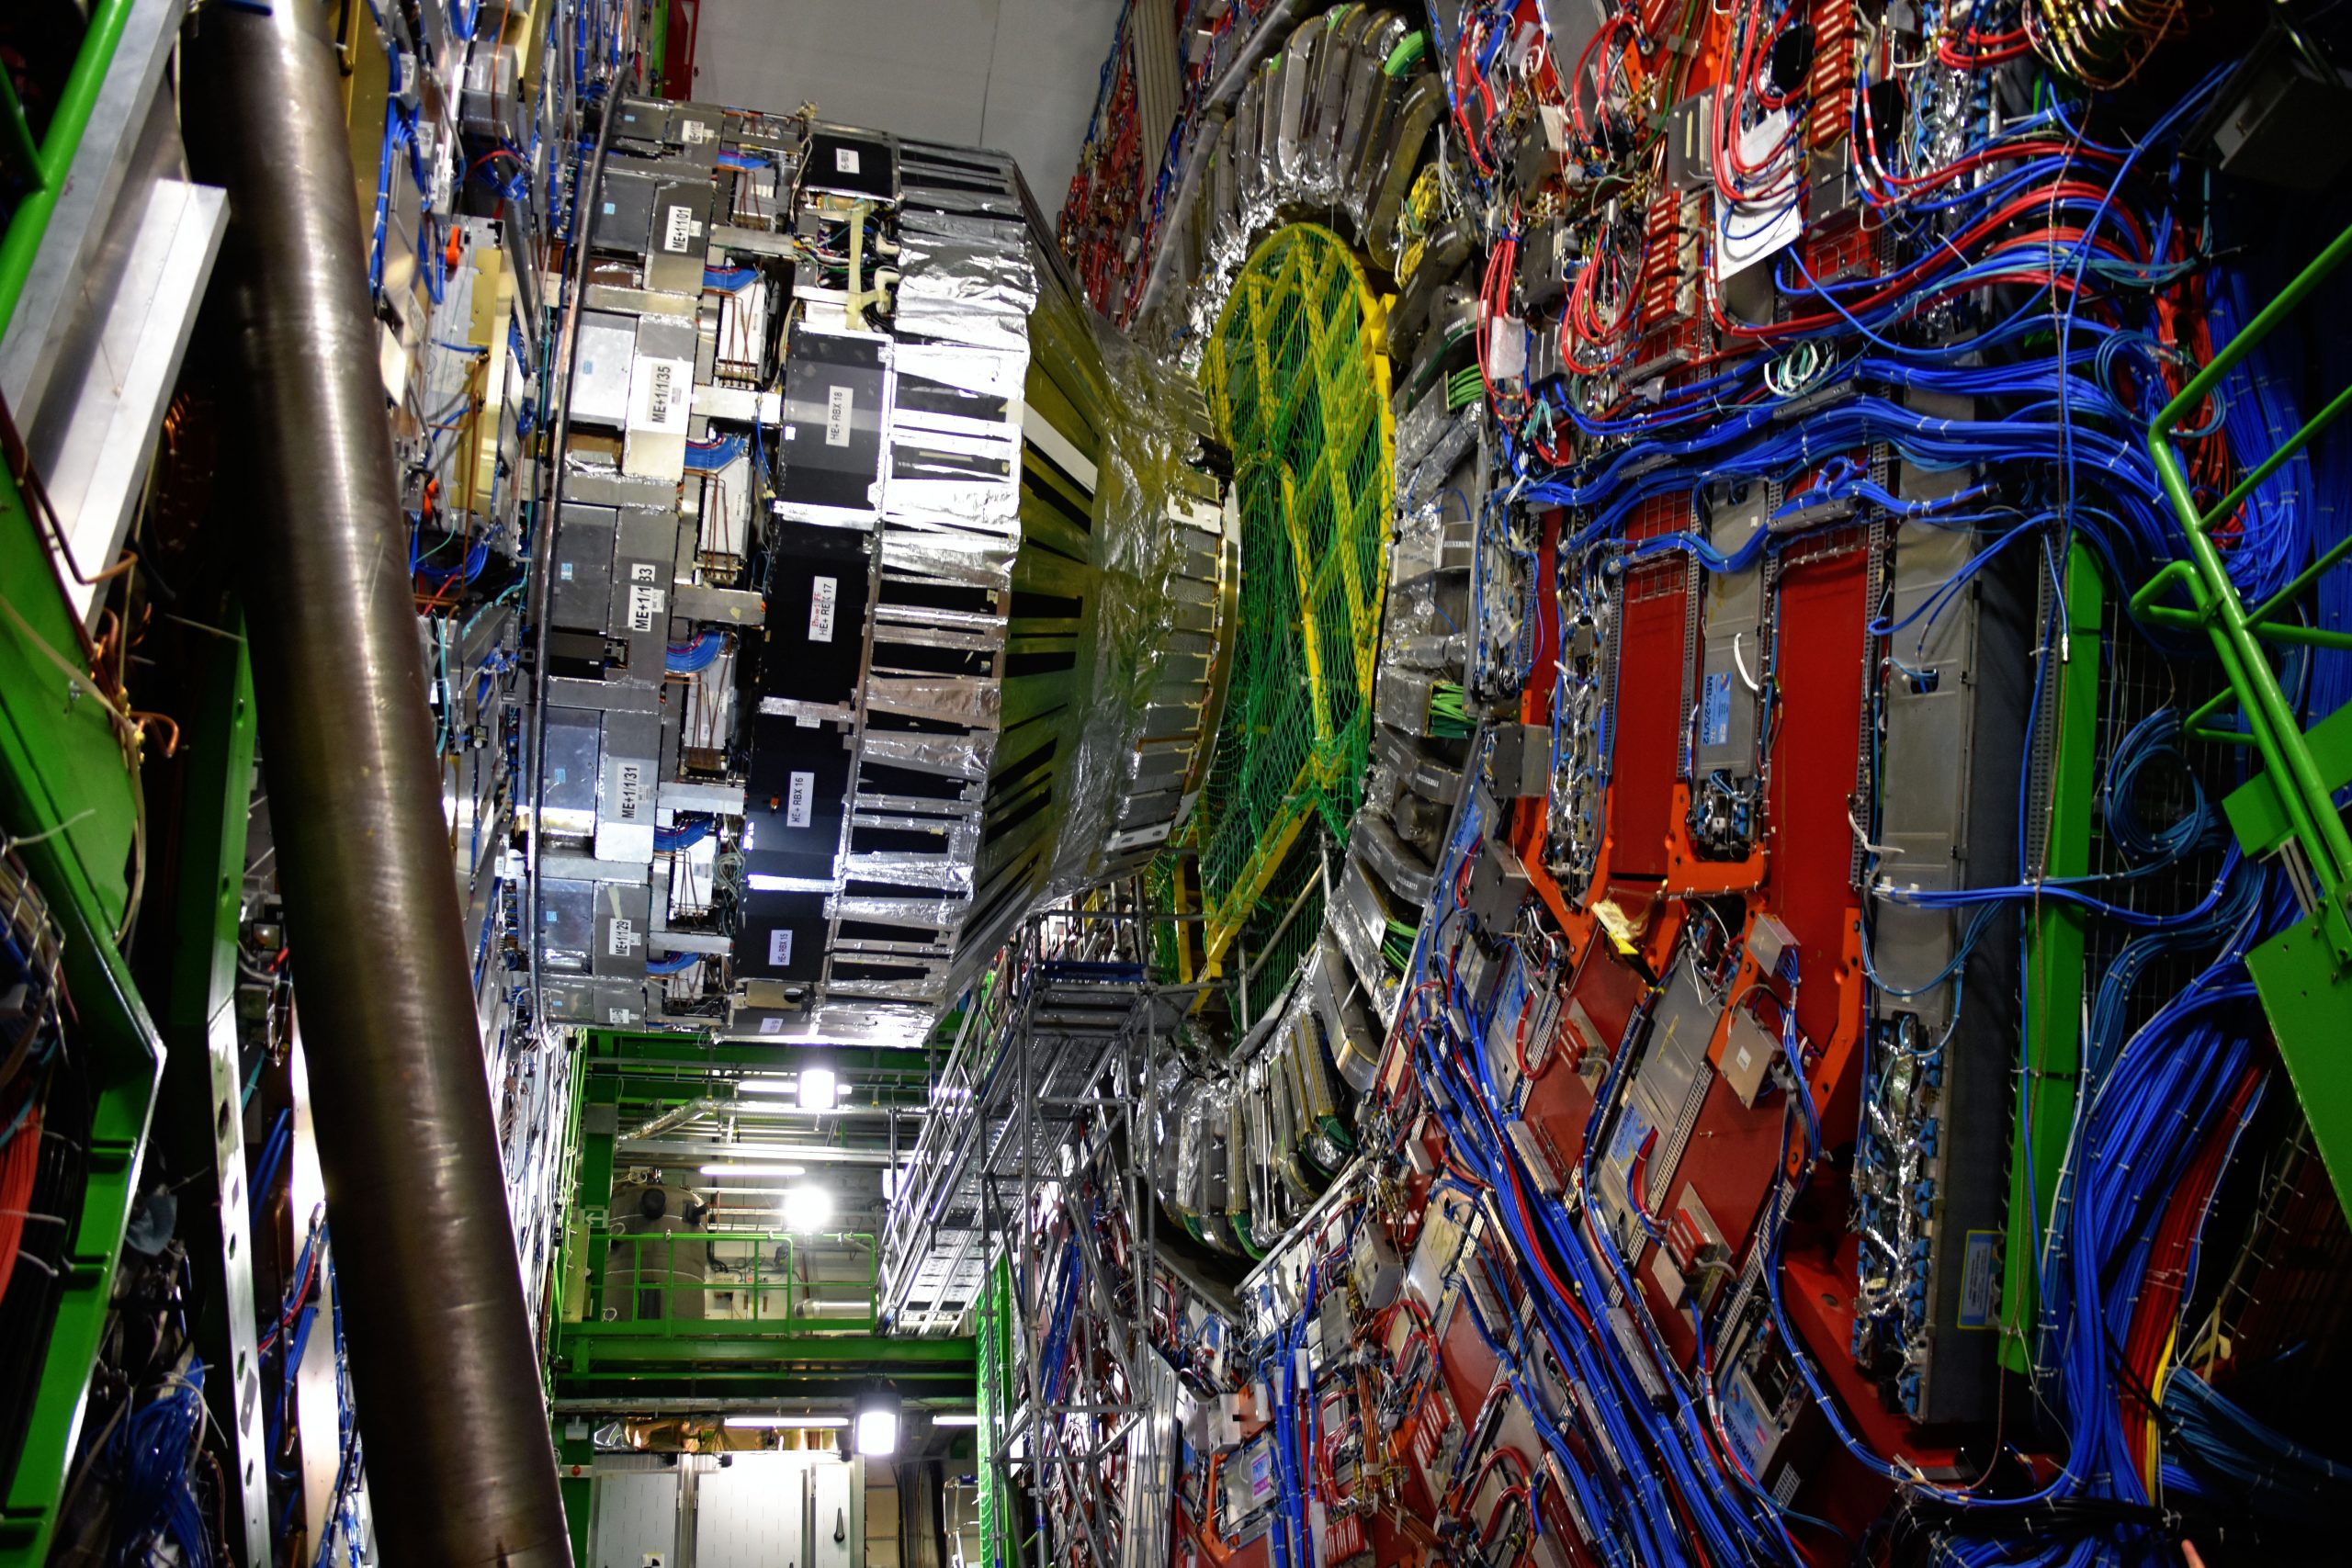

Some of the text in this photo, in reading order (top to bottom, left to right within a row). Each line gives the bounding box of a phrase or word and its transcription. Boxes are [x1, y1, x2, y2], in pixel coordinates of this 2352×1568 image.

[672, 209, 690, 249] ME+1/1/01
[651, 366, 671, 423] ME+1/1/35
[833, 391, 842, 401] 18
[831, 403, 842, 422] RBX
[823, 583, 832, 593] 17
[819, 618, 829, 636] HE+
[1702, 675, 1713, 745] MB/+2/3/12
[795, 777, 804, 787] 16
[621, 766, 638, 818] ME+1/1/31
[792, 788, 803, 806] RBX
[615, 920, 629, 955] ME+1/1/29
[778, 941, 787, 953] RBX
